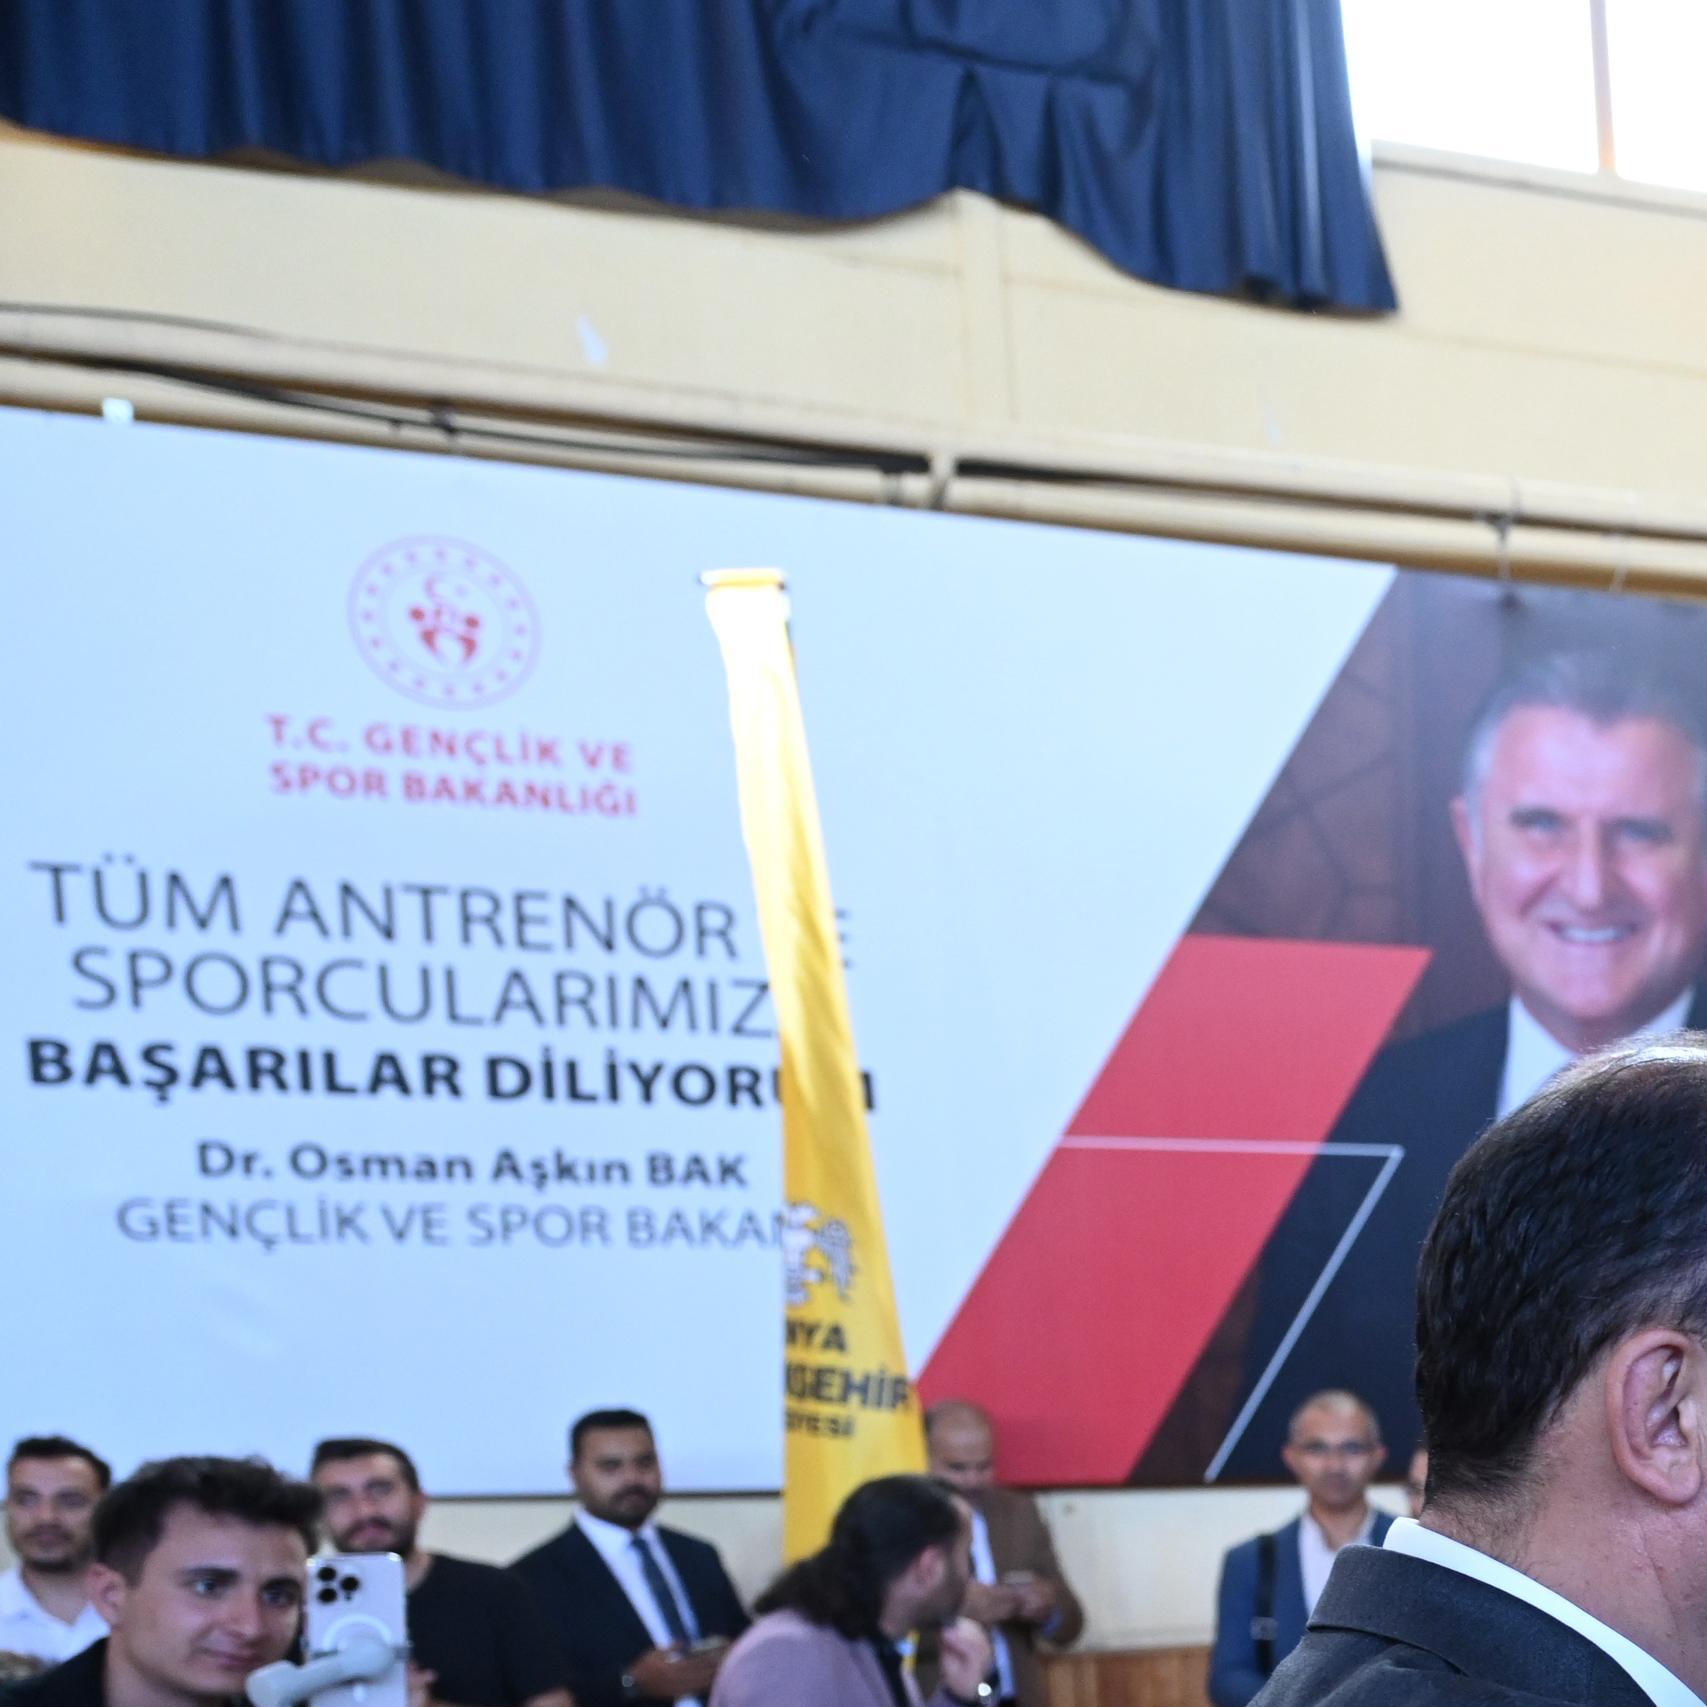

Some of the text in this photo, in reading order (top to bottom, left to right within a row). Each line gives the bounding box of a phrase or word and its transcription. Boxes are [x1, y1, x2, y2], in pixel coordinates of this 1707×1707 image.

[265, 713, 631, 774] T.C. GENÇLİK VE
[270, 761, 637, 818] SPOR BAKANLIĞI
[29, 853, 241, 934] TÜM
[272, 875, 738, 961] ANTRENÖR
[26, 1038, 877, 1111] BAŞARILAR DİLİYOR
[197, 1140, 748, 1192] Dr. Osman Aşkın BAK
[115, 1195, 369, 1252] GENÇLİK
[379, 1202, 448, 1247] VE
[465, 1202, 611, 1249] SPOR
